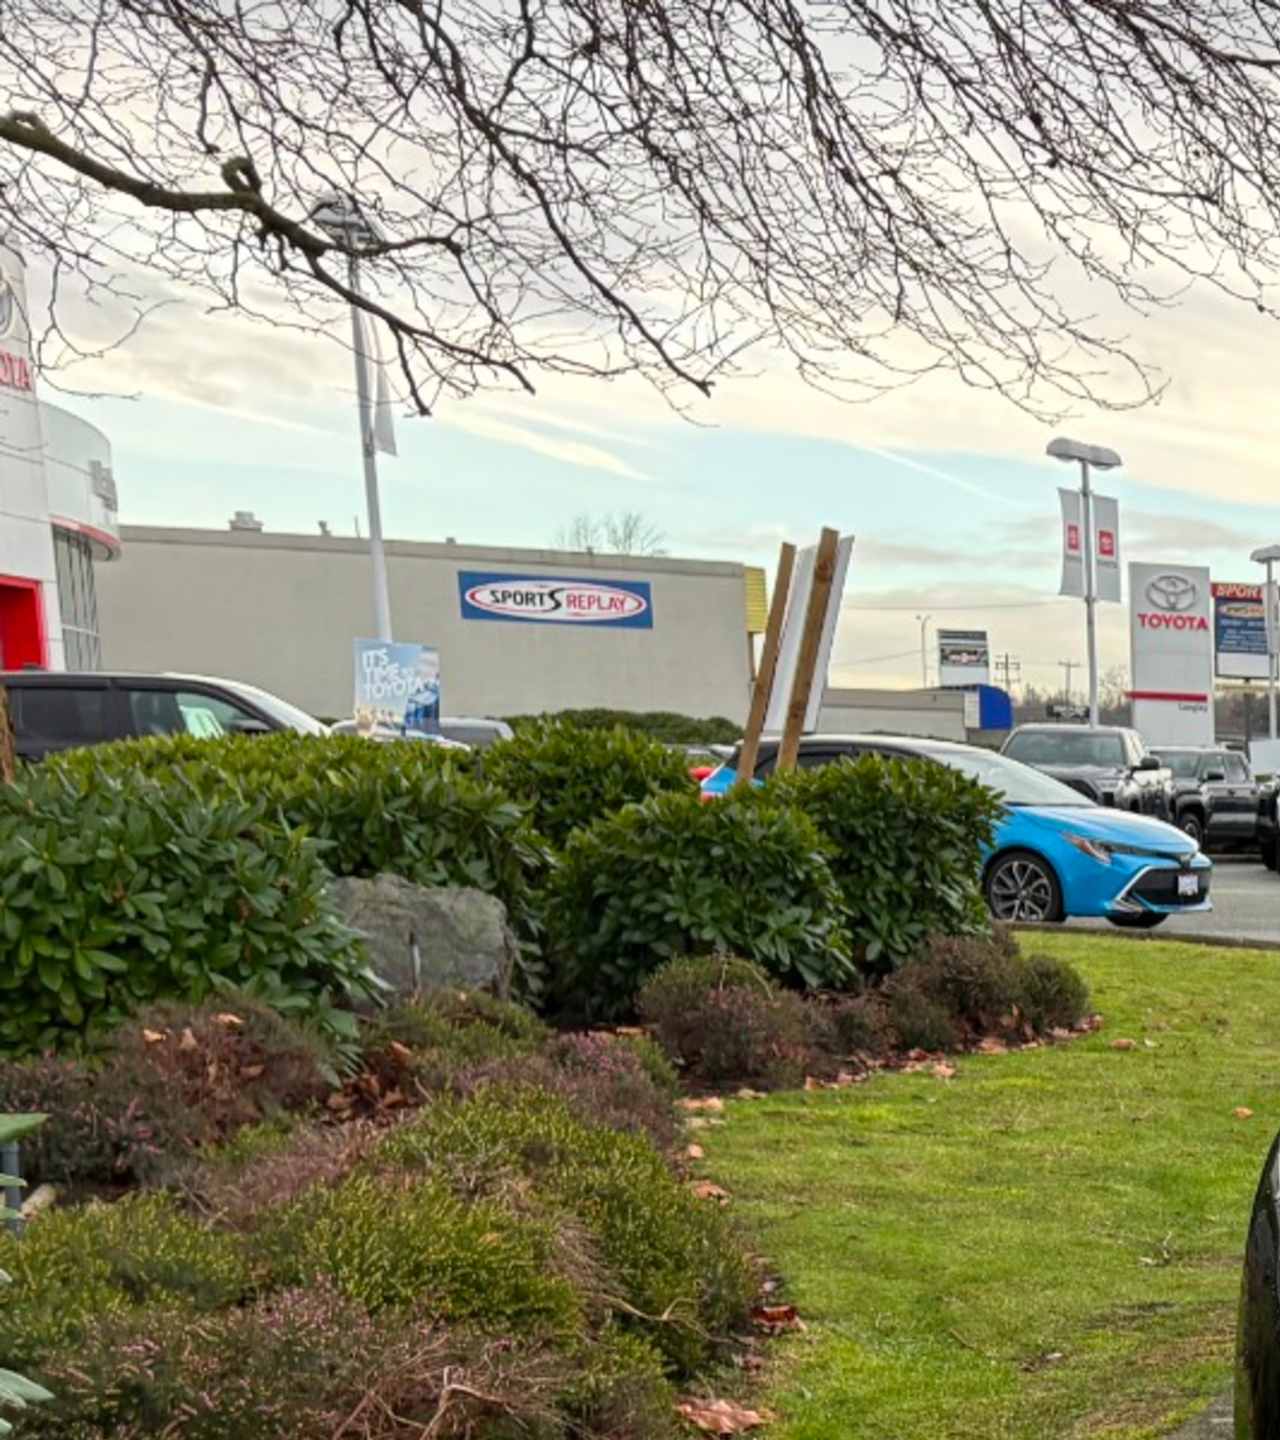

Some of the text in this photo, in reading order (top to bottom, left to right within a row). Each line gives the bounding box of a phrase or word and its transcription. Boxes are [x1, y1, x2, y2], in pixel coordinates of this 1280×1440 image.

[489, 588, 627, 612] SPORTS REPLAY
[1138, 613, 1209, 630] TOYOTA
